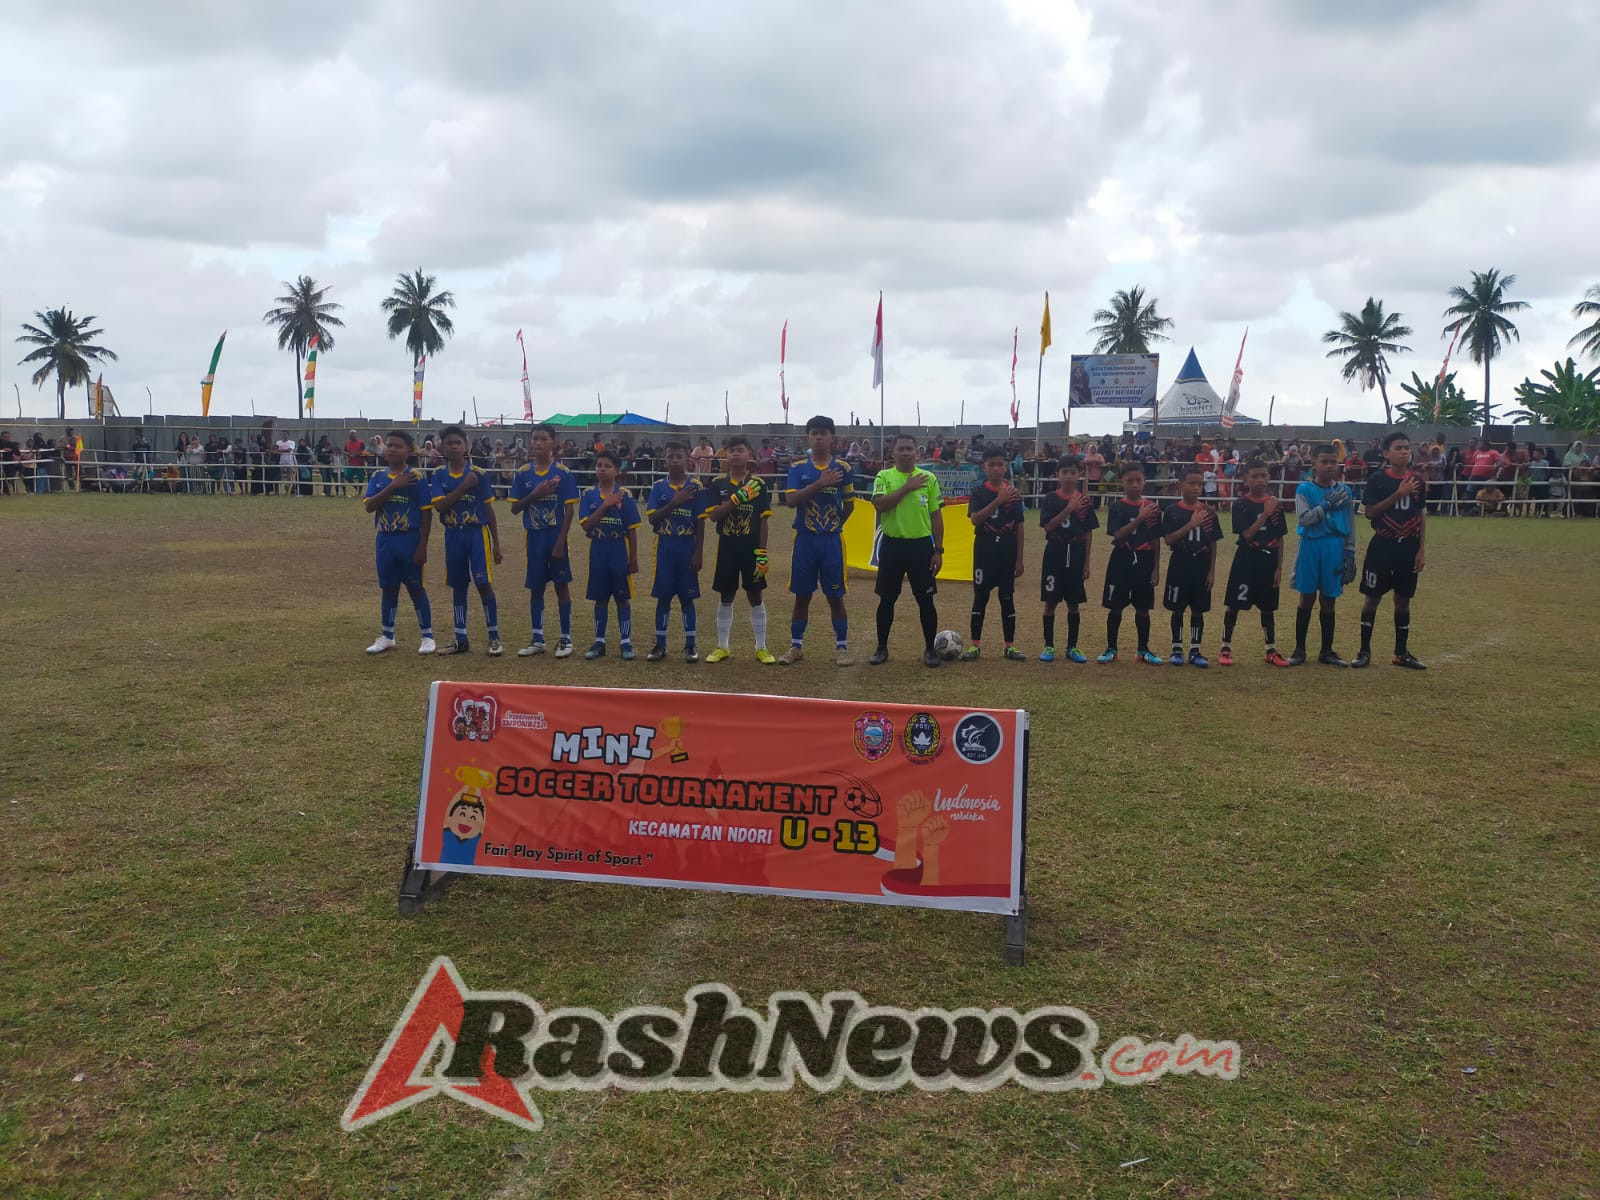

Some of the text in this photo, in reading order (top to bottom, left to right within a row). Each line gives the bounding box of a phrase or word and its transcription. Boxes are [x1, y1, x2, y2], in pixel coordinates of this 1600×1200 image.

[974, 568, 984, 585] 9
[1045, 575, 1055, 592] 3
[1237, 583, 1249, 601] 2
[552, 725, 656, 764] MINI
[496, 767, 837, 815] SOCCER TOURNAMENT
[934, 784, 1001, 812] Indonesia
[628, 820, 773, 845] KECAMATAN NDORI
[484, 843, 510, 857] Fair
[514, 844, 543, 862] Play
[546, 847, 583, 863] Spirit
[586, 850, 601, 863] of
